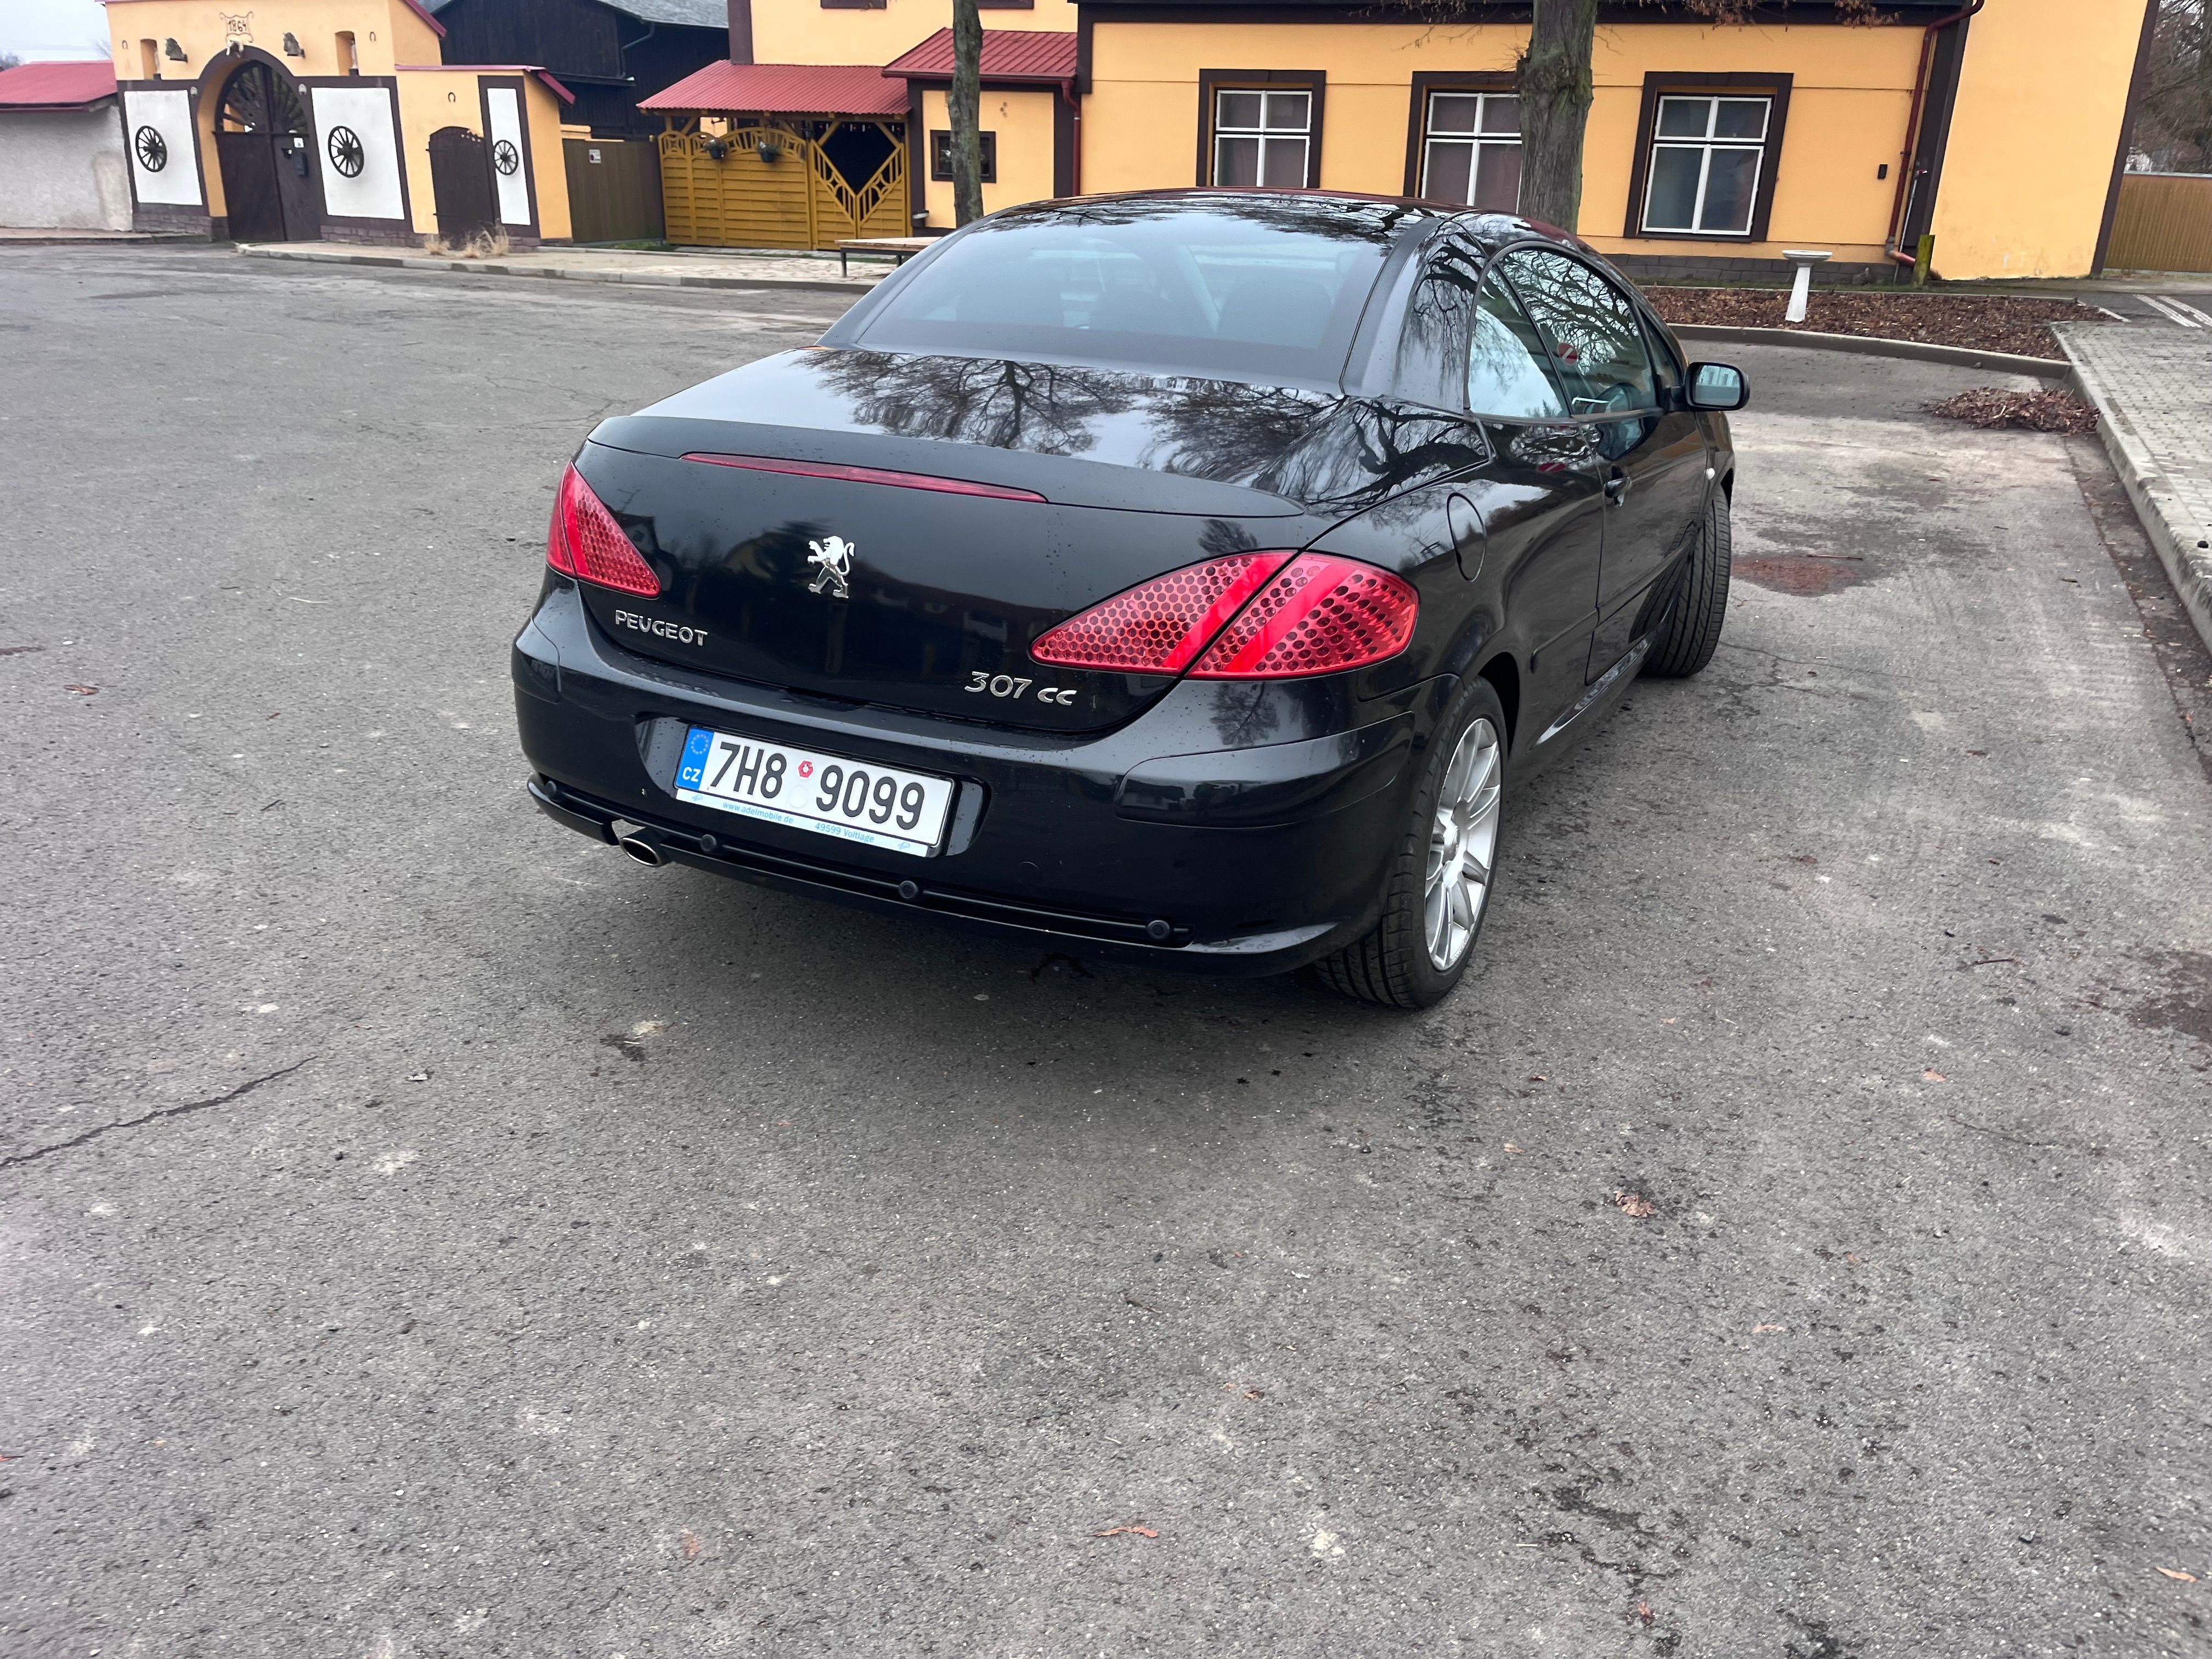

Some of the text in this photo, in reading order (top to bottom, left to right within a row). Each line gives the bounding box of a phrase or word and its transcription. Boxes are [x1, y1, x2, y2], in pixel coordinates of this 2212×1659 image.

[228, 19, 246, 31] 1864
[615, 610, 708, 646] PEUGEOT
[964, 671, 1032, 699] 307
[682, 766, 701, 782] CZ
[710, 742, 925, 830] 7H8 9099
[723, 802, 874, 843] www.adelmobile.de 49599 Voltlage
